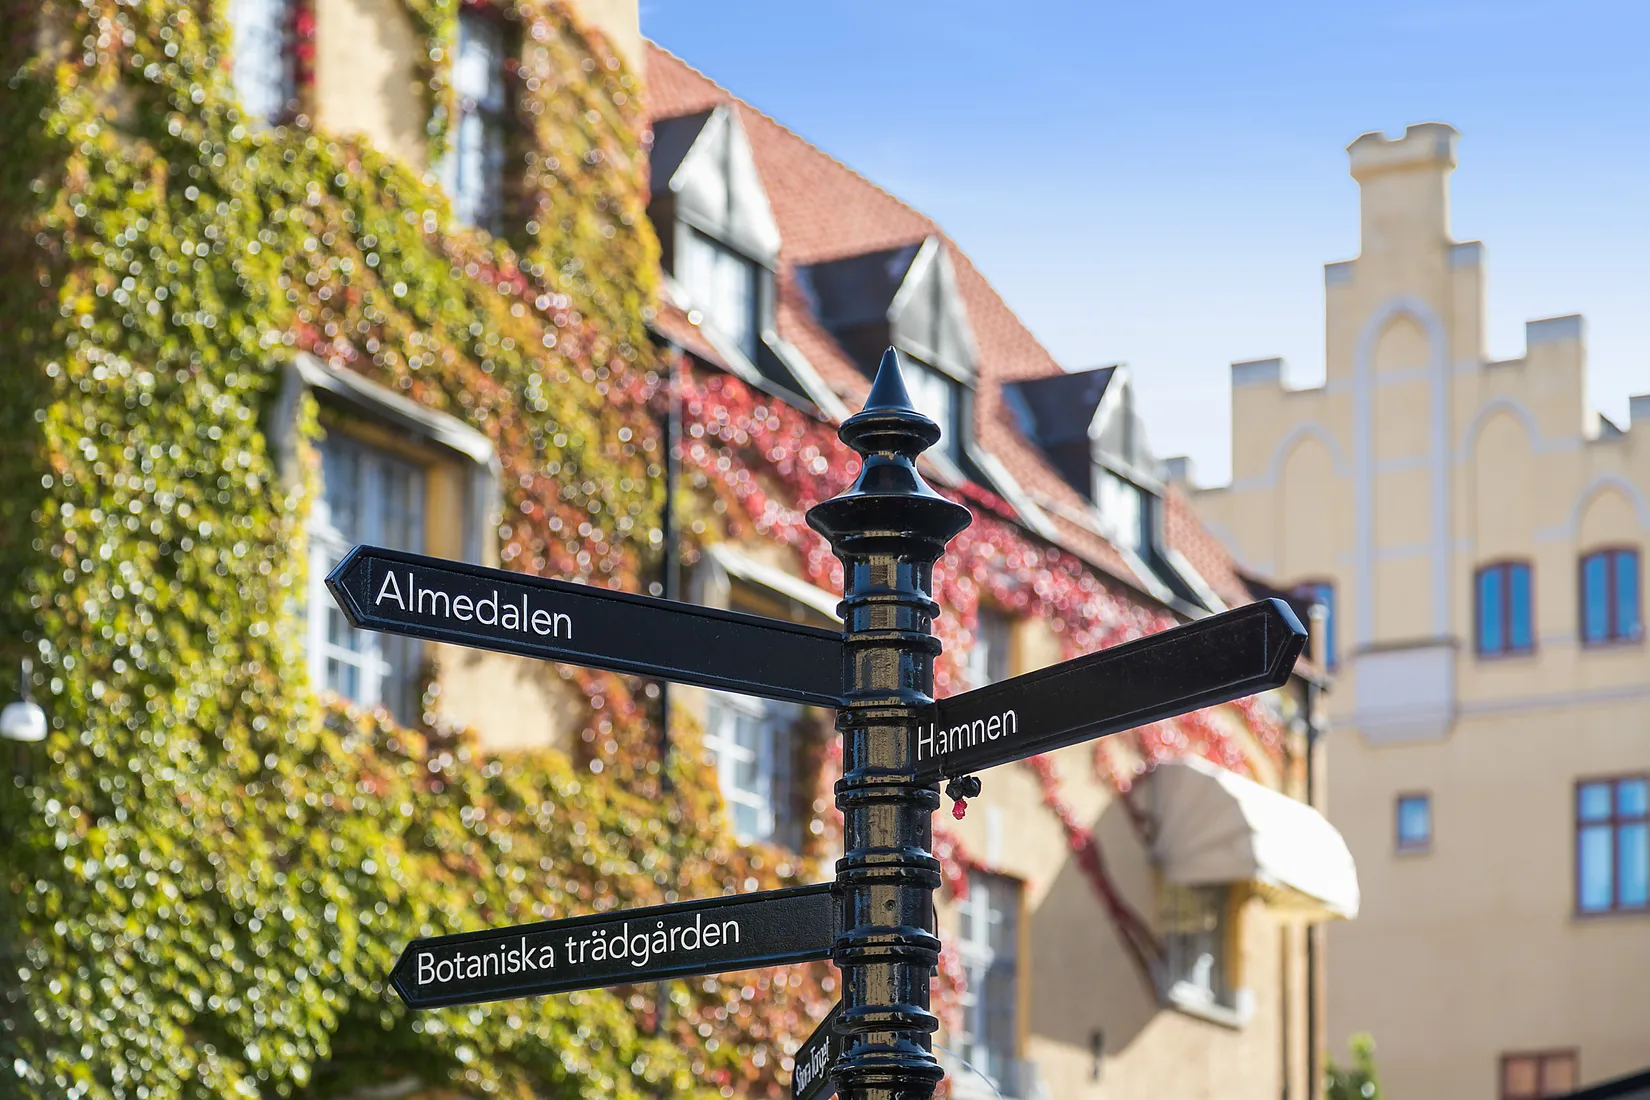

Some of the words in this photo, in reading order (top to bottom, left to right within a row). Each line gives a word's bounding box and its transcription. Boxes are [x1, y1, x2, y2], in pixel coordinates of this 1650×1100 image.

[375, 570, 572, 639] Almedalen
[917, 709, 1017, 761] Hamnen
[417, 937, 555, 985] Botaniska
[565, 913, 740, 967] trädgården
